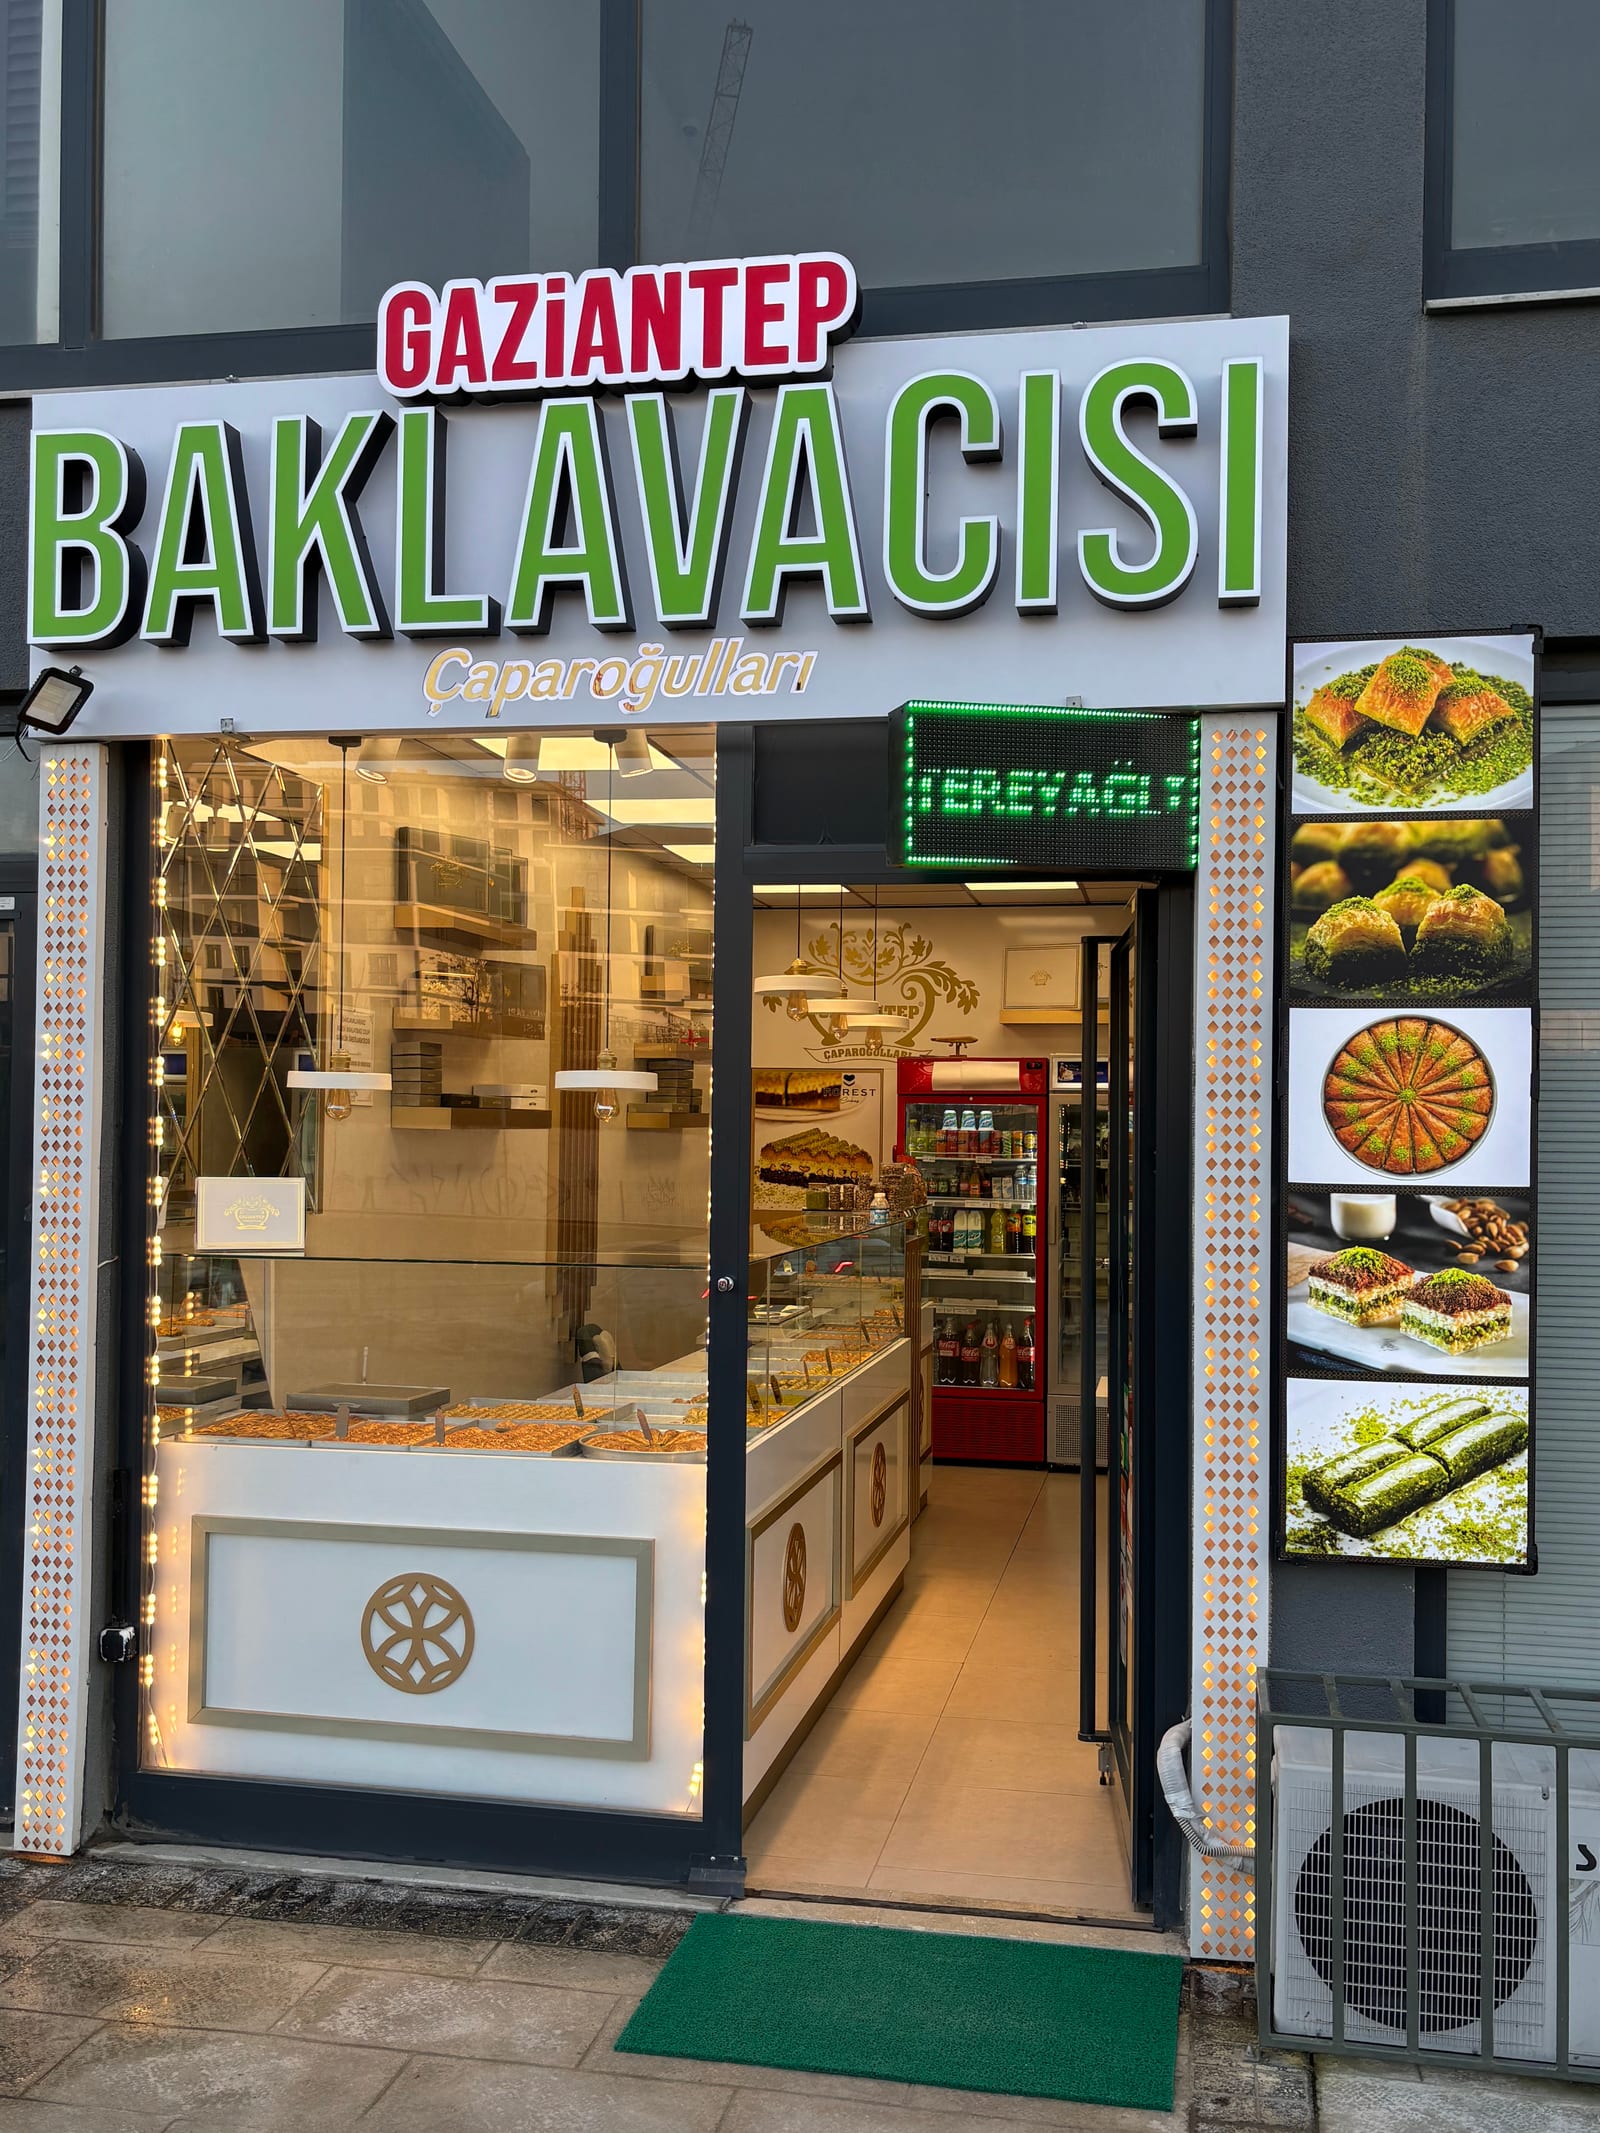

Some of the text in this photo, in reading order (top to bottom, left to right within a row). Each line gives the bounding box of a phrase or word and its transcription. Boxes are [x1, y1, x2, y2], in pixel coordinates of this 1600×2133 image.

[27, 356, 1264, 646] BAKLAVACISI
[423, 637, 818, 717] Çaparoğulları
[823, 1087, 876, 1097] FOREST
